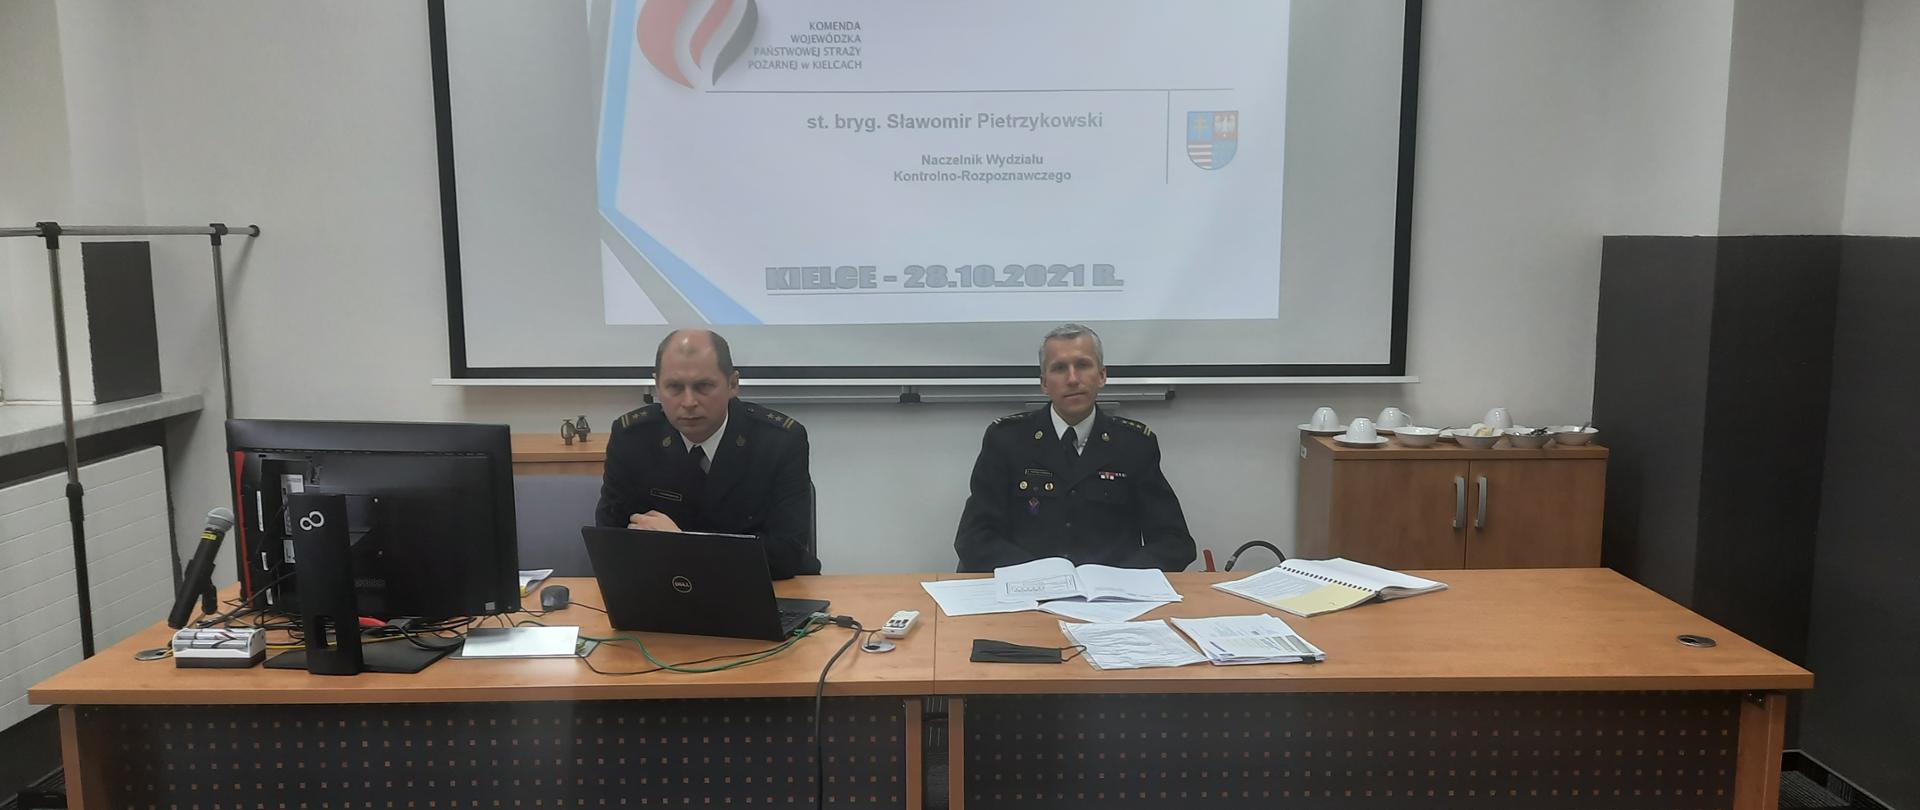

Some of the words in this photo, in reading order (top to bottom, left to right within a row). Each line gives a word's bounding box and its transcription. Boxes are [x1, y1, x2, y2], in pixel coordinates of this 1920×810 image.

[809, 21, 861, 31] KOMENDA
[790, 33, 862, 44] WOJEWÓDZKA
[813, 60, 862, 70] KIELCACH
[807, 115, 829, 130] st.
[835, 114, 881, 133] bryg.
[887, 113, 972, 130] Sławomir
[977, 112, 1104, 131] Pietrzykowski
[921, 154, 983, 167] Naczelnik
[893, 169, 1072, 184] Kontrolno-Rozpoznawczego
[765, 265, 878, 290] KIELCE
[903, 263, 1085, 289] 28.10.2021
[1092, 264, 1125, 287] R.
